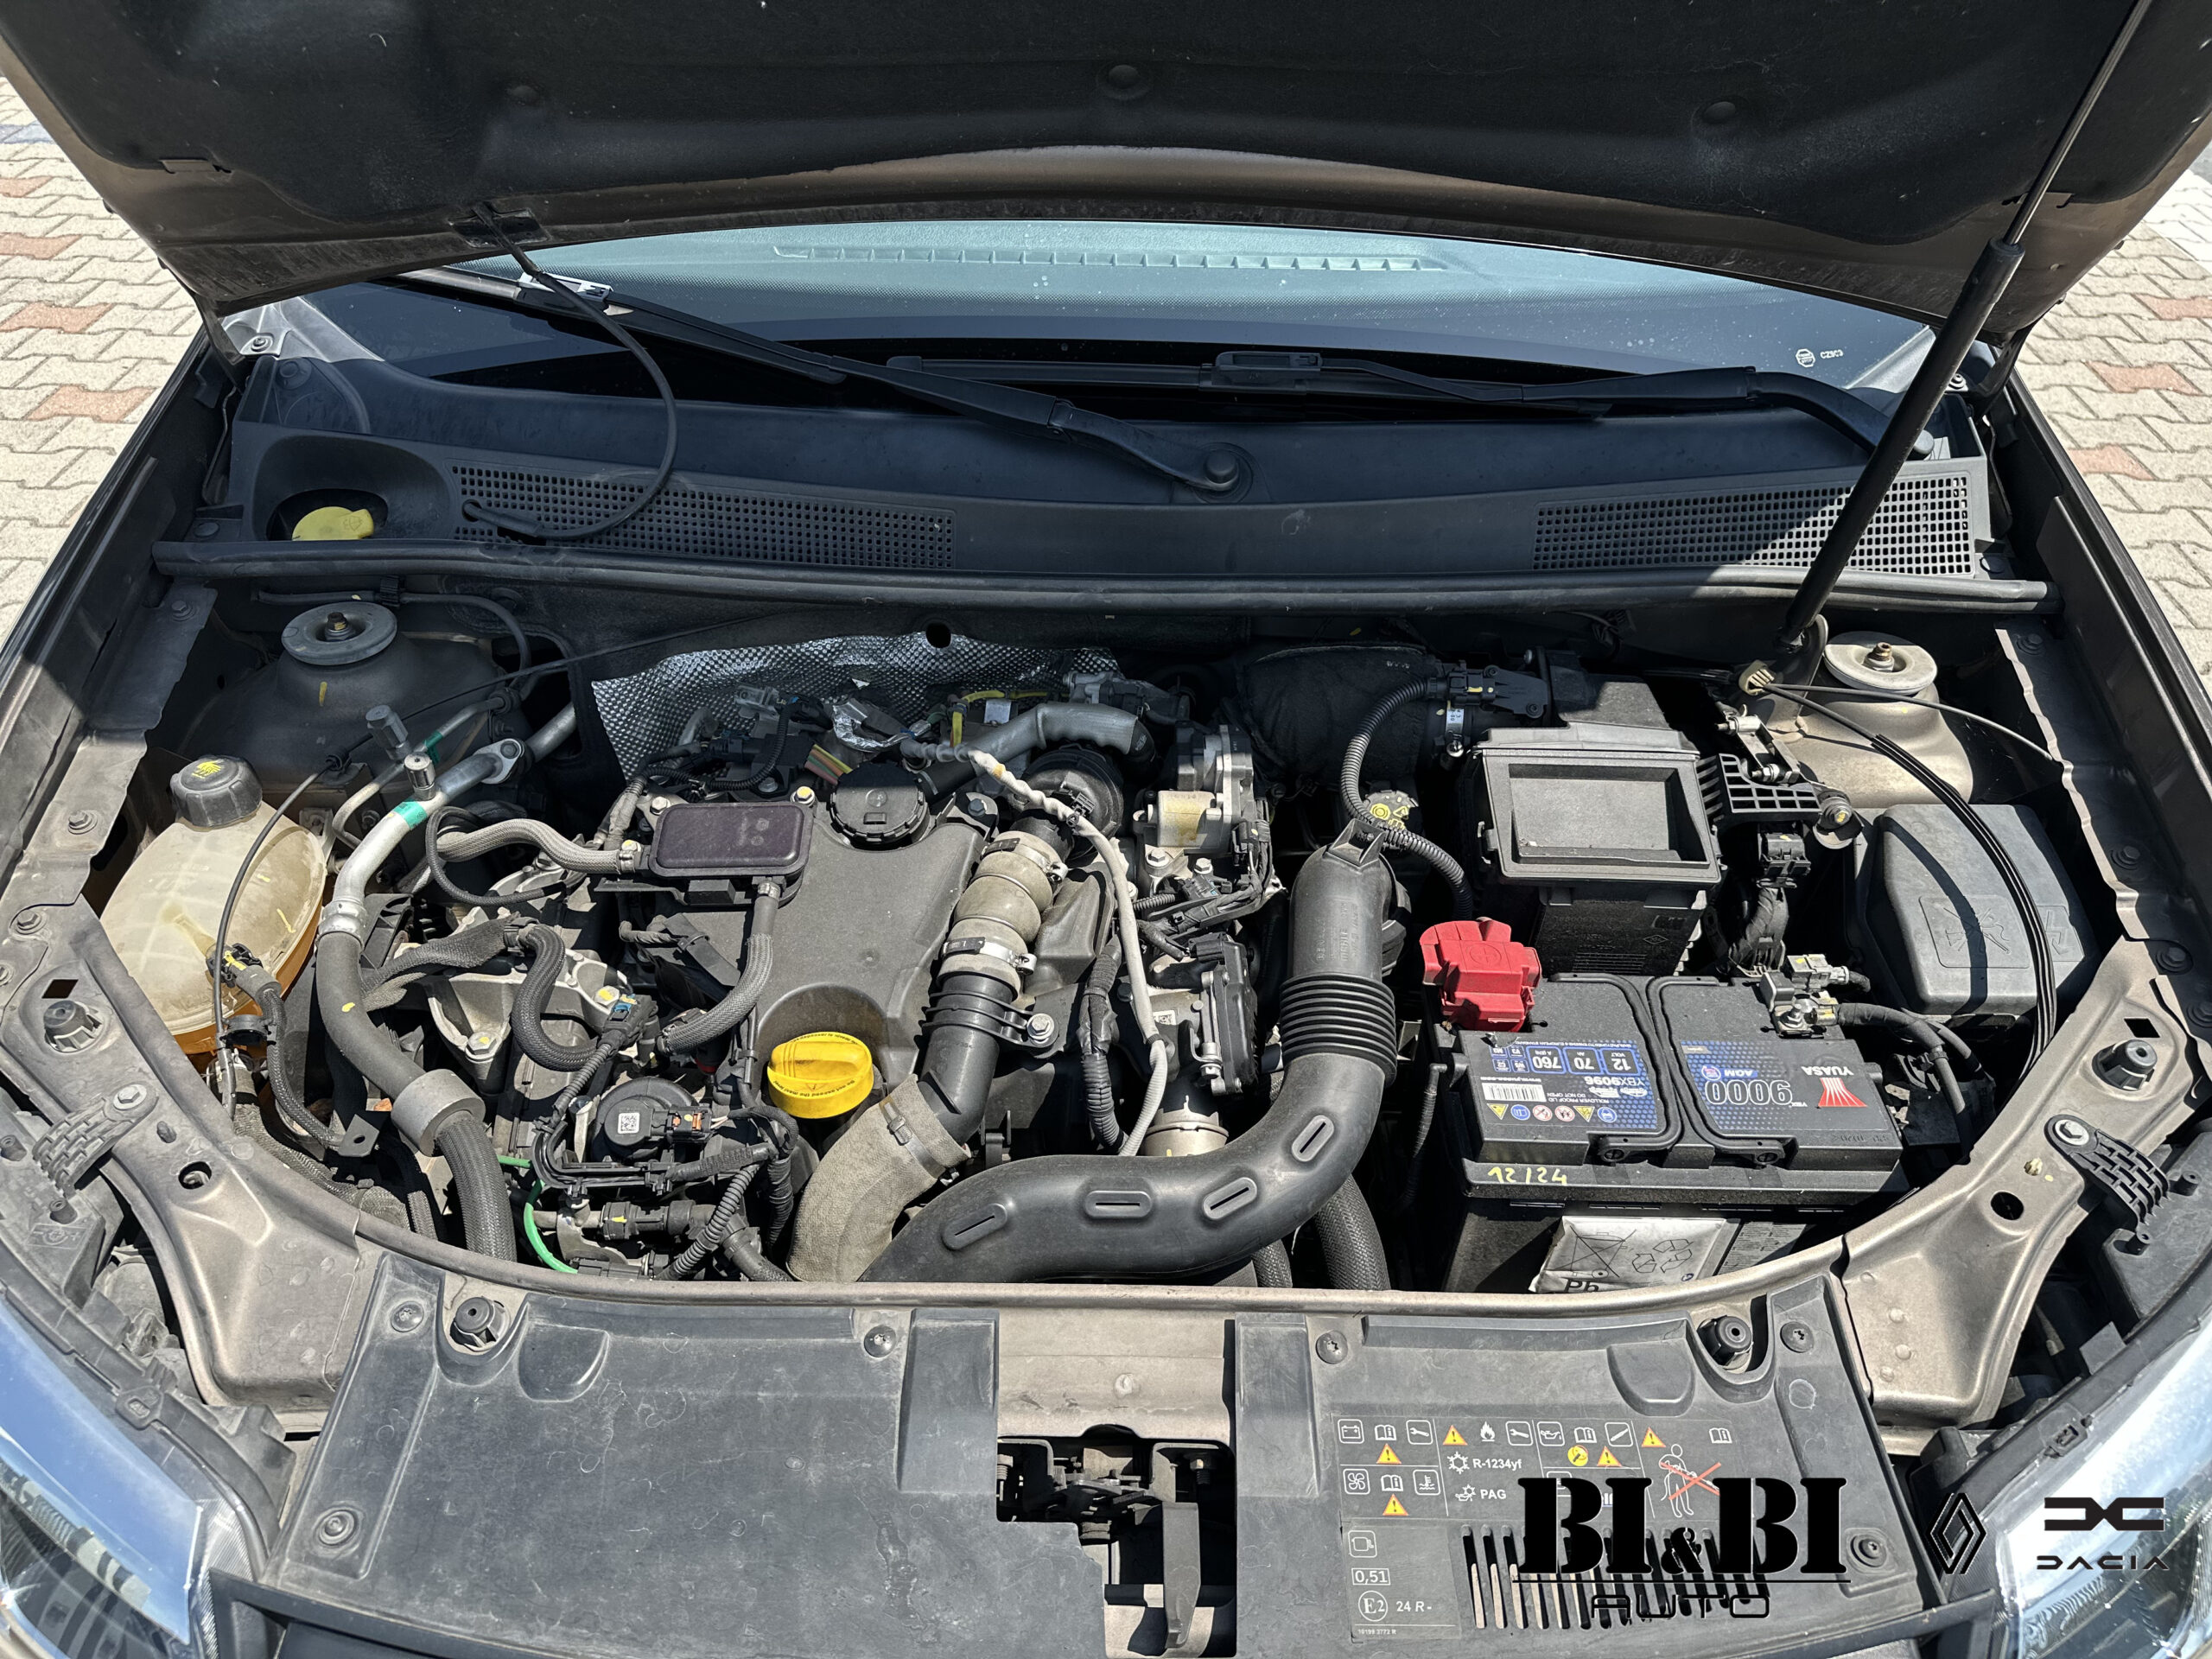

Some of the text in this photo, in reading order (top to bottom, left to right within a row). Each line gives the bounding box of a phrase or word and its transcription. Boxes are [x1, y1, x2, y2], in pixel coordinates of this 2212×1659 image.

[1532, 1056, 1562, 1069] 760
[1573, 1057, 1595, 1070] 70
[1611, 1058, 1632, 1071] 12
[1724, 1069, 1753, 1077] AGM
[1801, 1065, 1855, 1077] YUASA
[1584, 1076, 1646, 1086] YBX9096
[1704, 1079, 1793, 1105] 9000
[1472, 1458, 1522, 1471] R-1234yf
[1479, 1489, 1507, 1500] PAG
[1354, 1570, 1389, 1585] 0,51
[1395, 1600, 1412, 1612] 24
